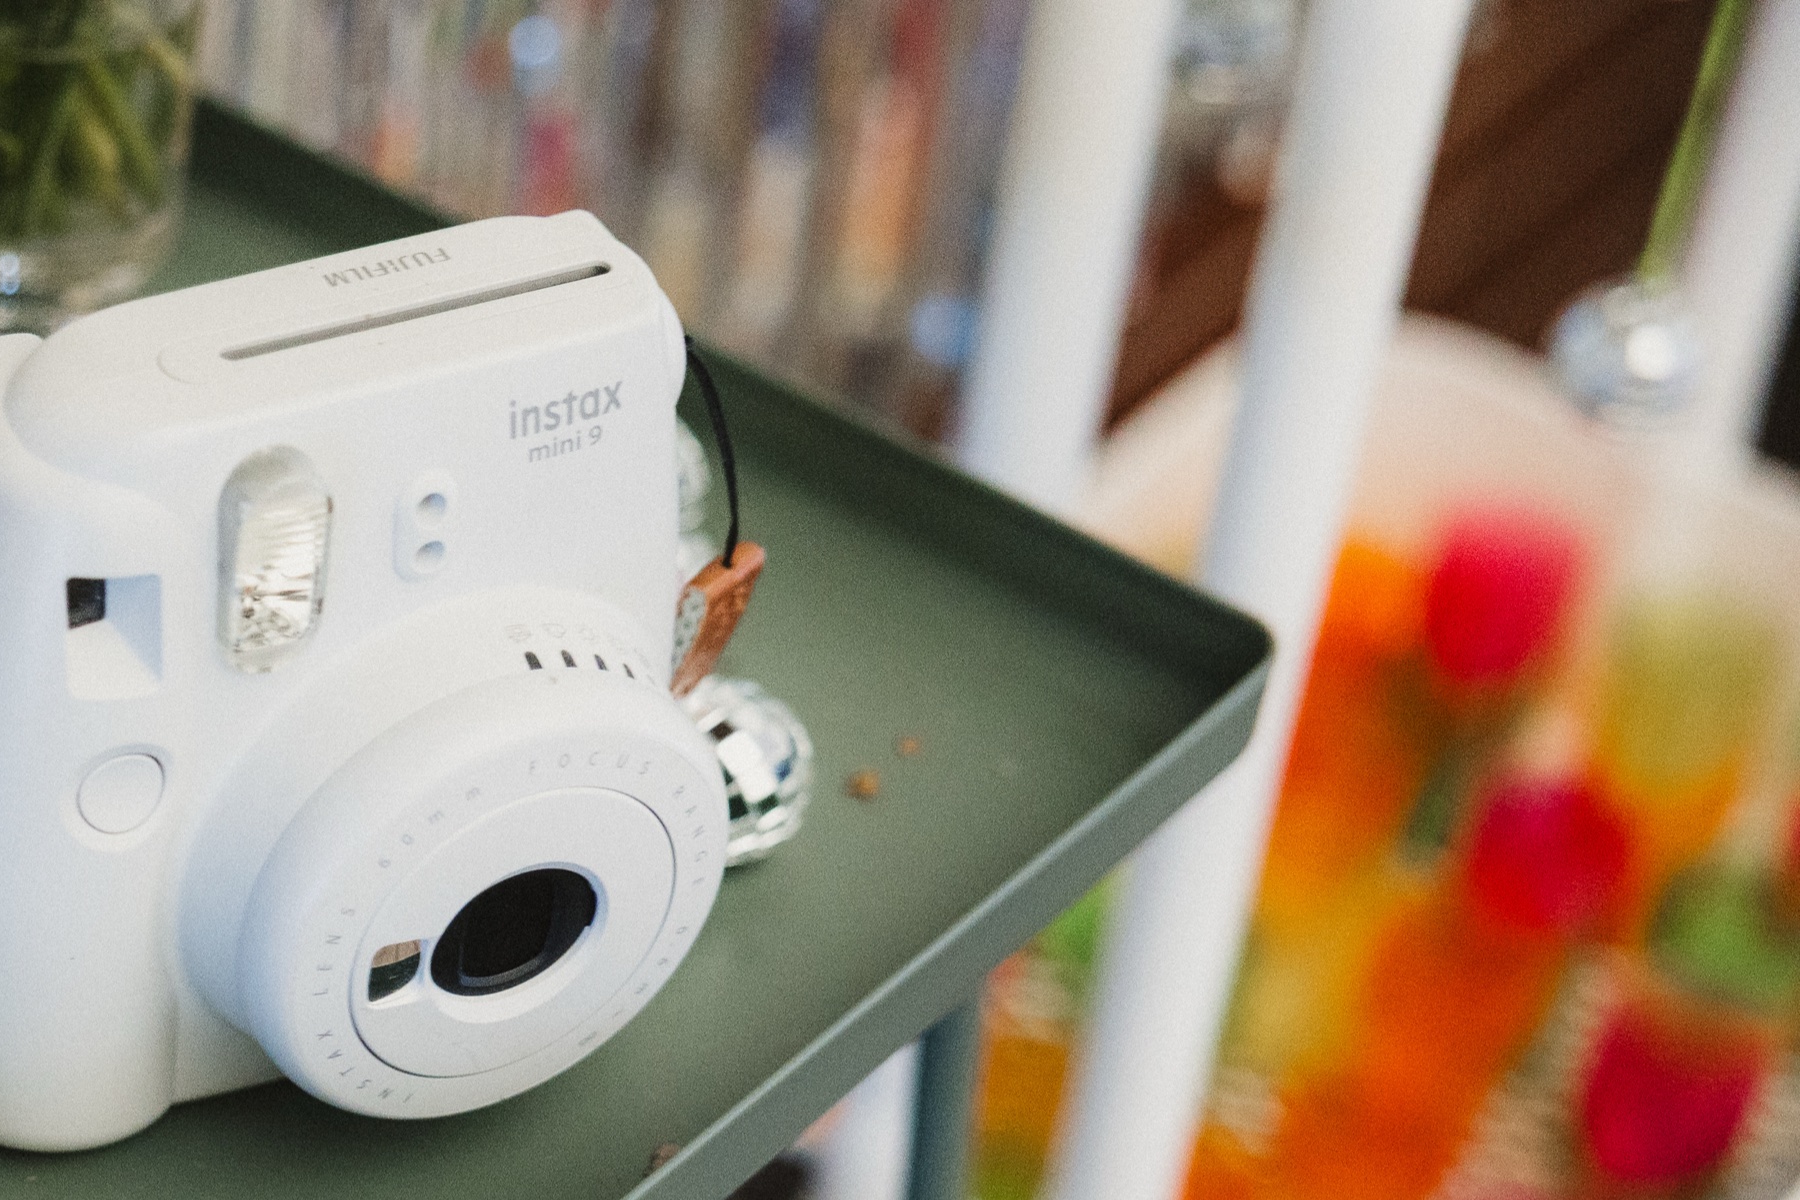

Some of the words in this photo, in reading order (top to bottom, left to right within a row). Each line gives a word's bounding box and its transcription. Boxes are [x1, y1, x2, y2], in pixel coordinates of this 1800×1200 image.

[321, 247, 452, 288] FUJIFILM
[509, 381, 623, 440] instax
[528, 430, 583, 463] mini
[587, 425, 603, 446] 9
